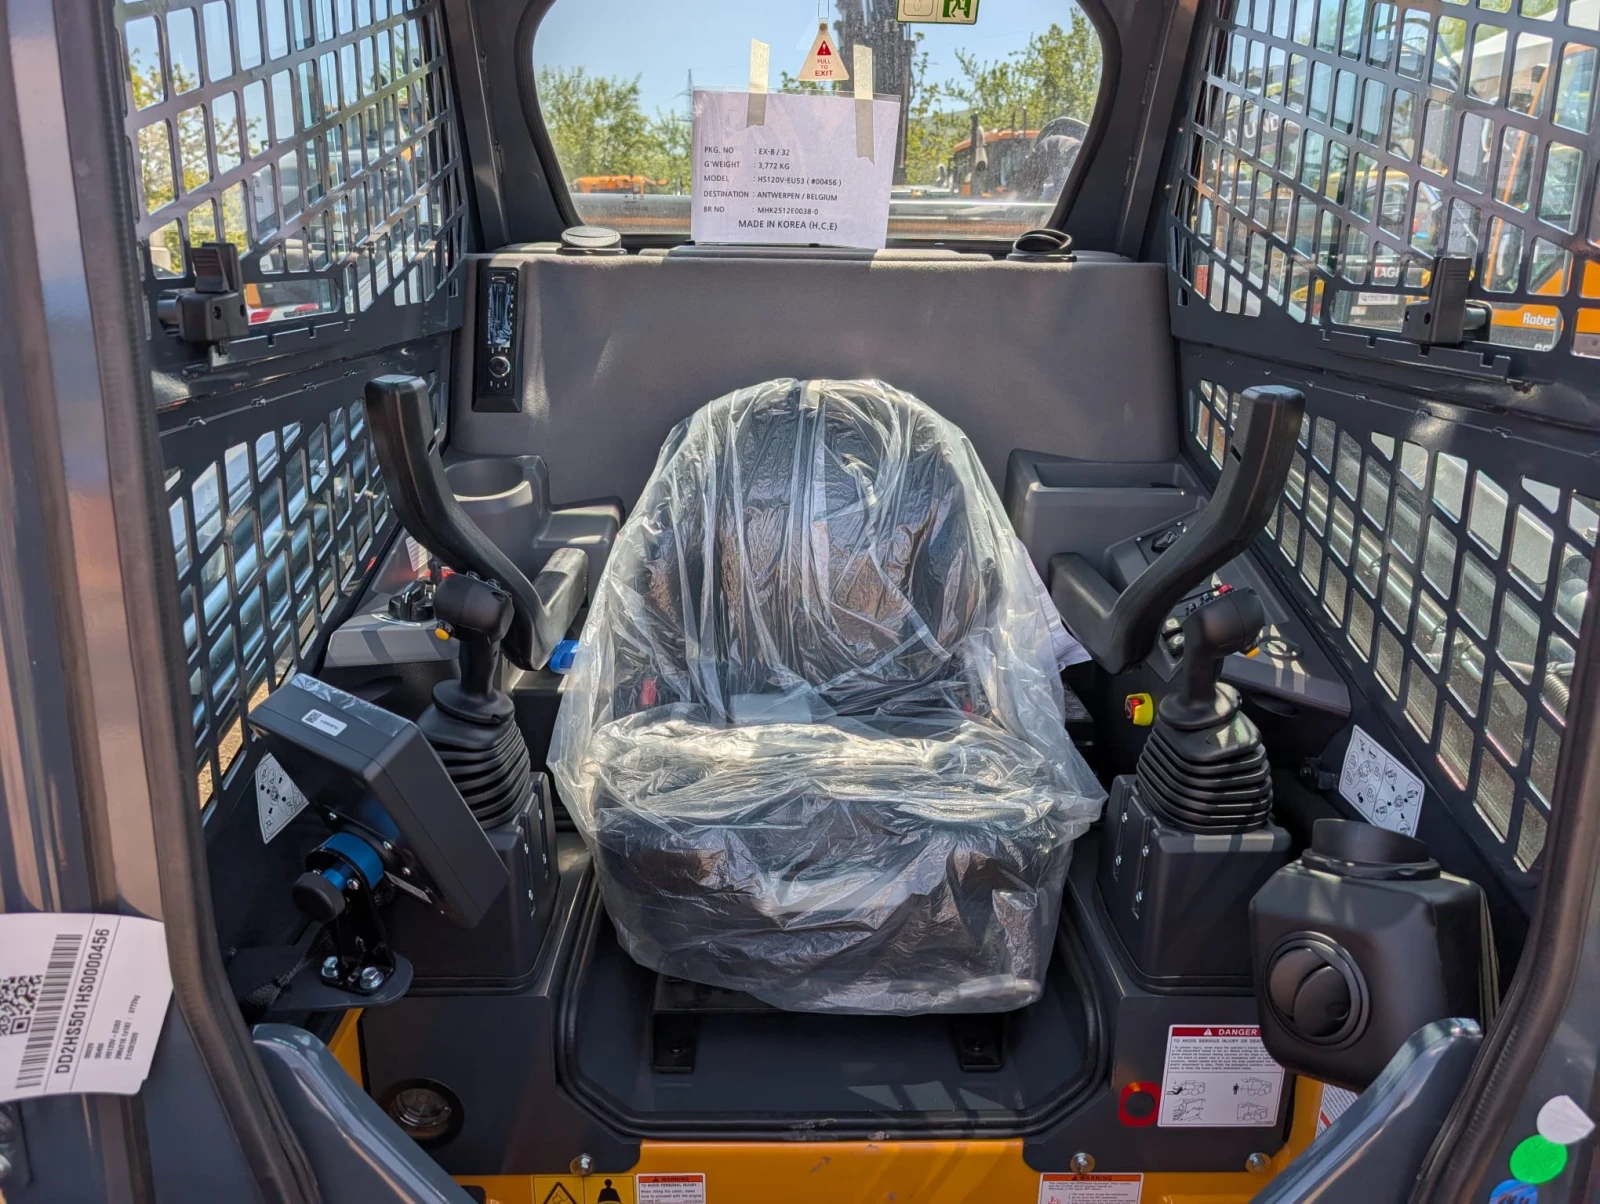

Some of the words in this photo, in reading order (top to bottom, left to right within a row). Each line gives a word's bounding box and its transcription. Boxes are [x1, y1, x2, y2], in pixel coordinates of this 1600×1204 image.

[757, 192, 800, 200] ANTWERPEN
[738, 220, 764, 228] MADE
[766, 220, 775, 228] IN
[778, 220, 806, 229] KOREA
[55, 928, 110, 1074] DD2HS501HS000456
[1218, 1028, 1258, 1036] DANGER
